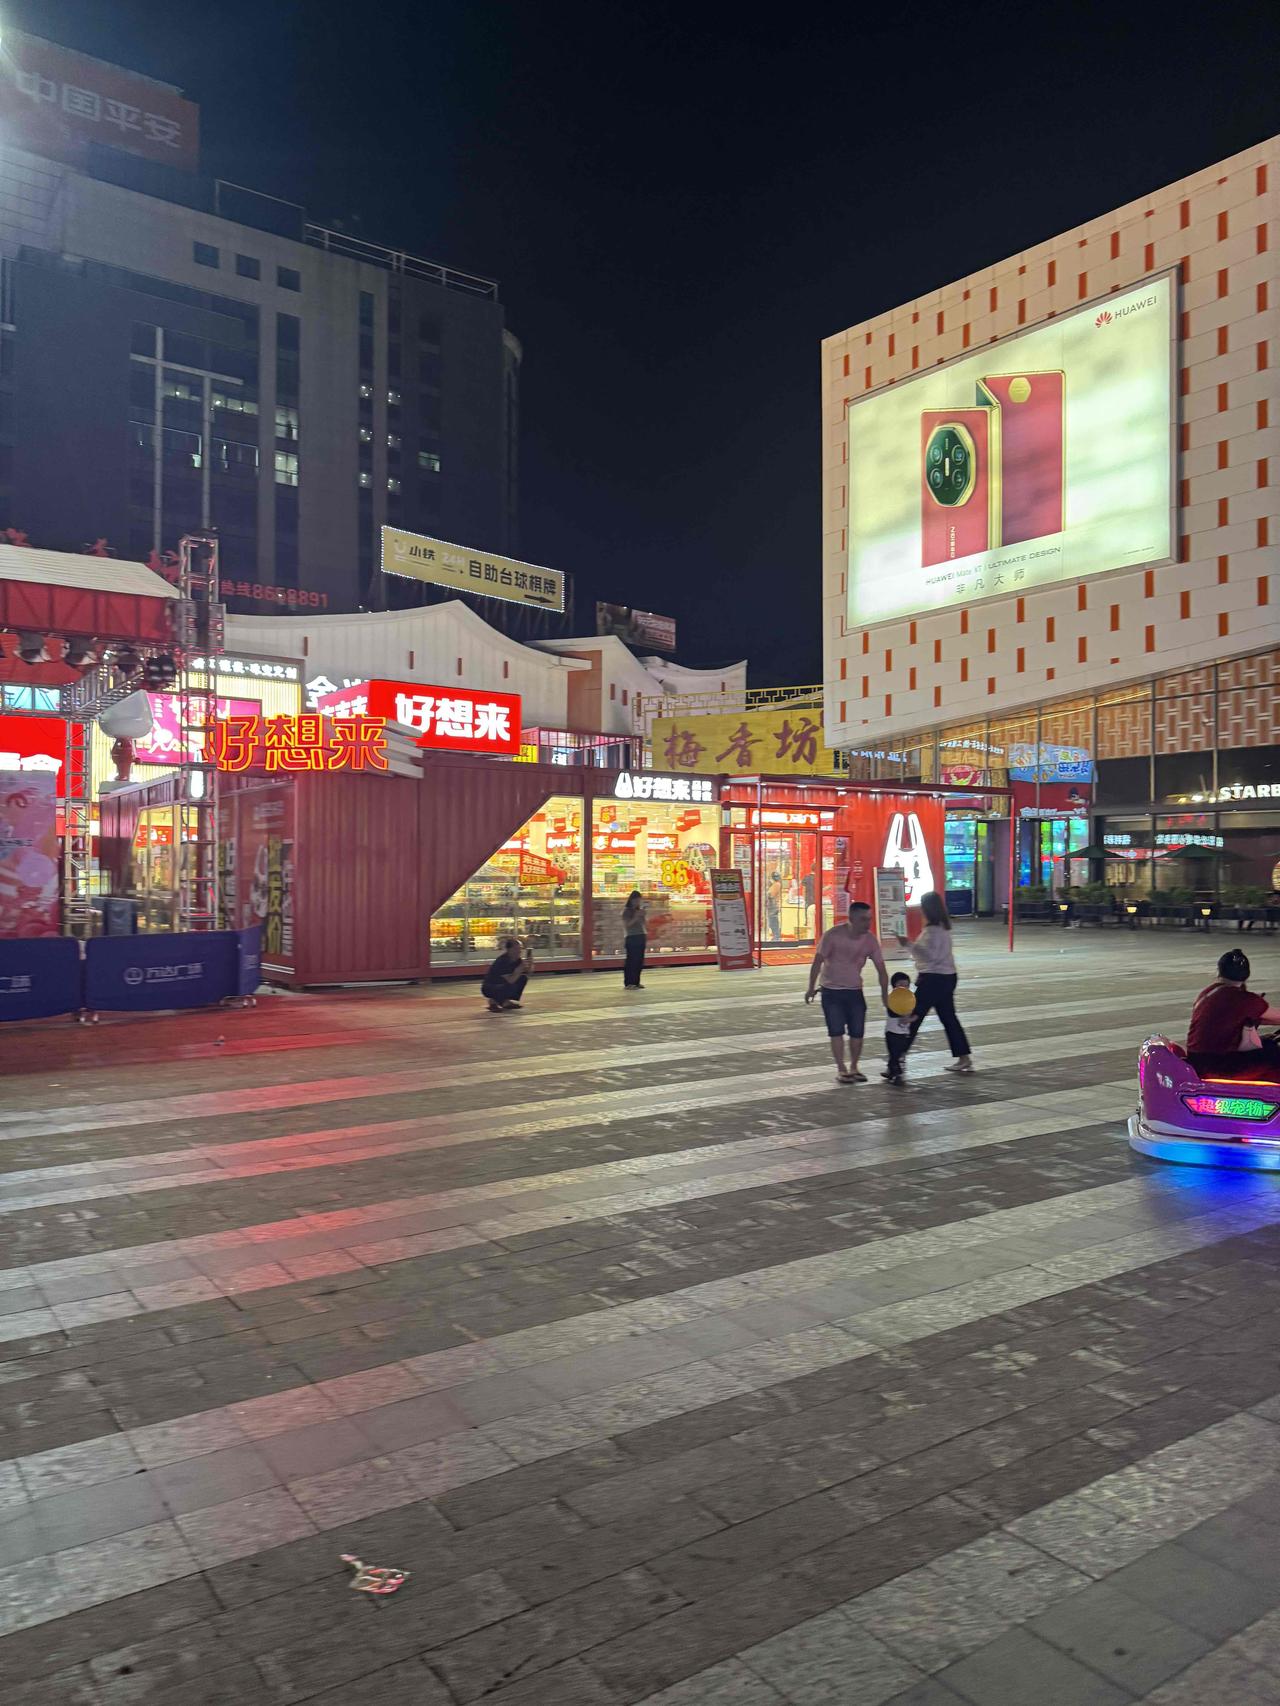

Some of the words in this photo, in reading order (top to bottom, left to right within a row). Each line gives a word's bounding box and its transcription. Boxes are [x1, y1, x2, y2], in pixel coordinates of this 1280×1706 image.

[16, 71, 182, 148] 中国平安
[1115, 296, 1157, 319] HUAWEI
[409, 545, 436, 561] 小铁
[469, 560, 557, 595] 自助台球棋牌
[926, 571, 955, 585] HUAWEI
[988, 554, 1026, 570] ULTIMATE
[1029, 546, 1062, 560] DESIGN
[956, 568, 1025, 594] 非凡大师
[395, 693, 511, 741] 好想来
[204, 713, 389, 772] 好想来
[664, 717, 820, 769] 梅香坊
[633, 776, 690, 800] 好想来
